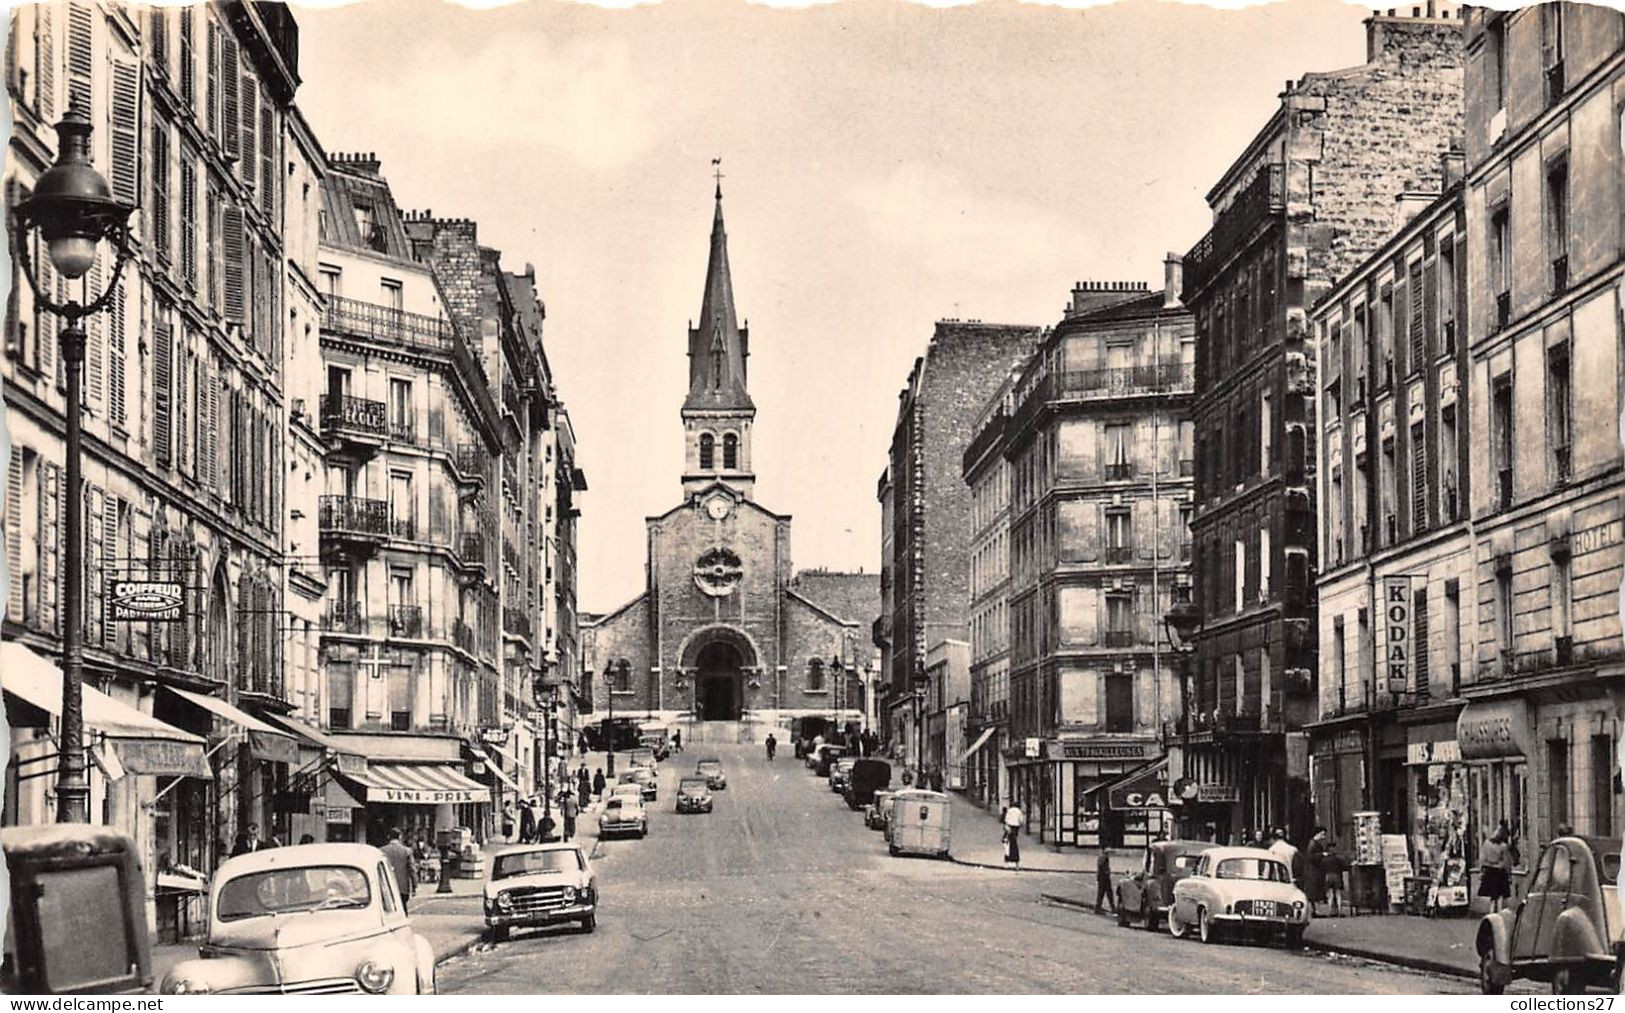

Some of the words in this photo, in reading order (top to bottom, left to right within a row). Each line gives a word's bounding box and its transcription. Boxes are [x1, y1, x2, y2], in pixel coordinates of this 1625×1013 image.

[345, 408, 380, 427] ECOLE
[1574, 525, 1614, 556] HOTEL
[115, 583, 181, 599] COIFFEUR
[115, 606, 180, 619] PARFUMEUR
[1389, 585, 1406, 679] KODAK
[1460, 718, 1511, 745] CHAUSSURES
